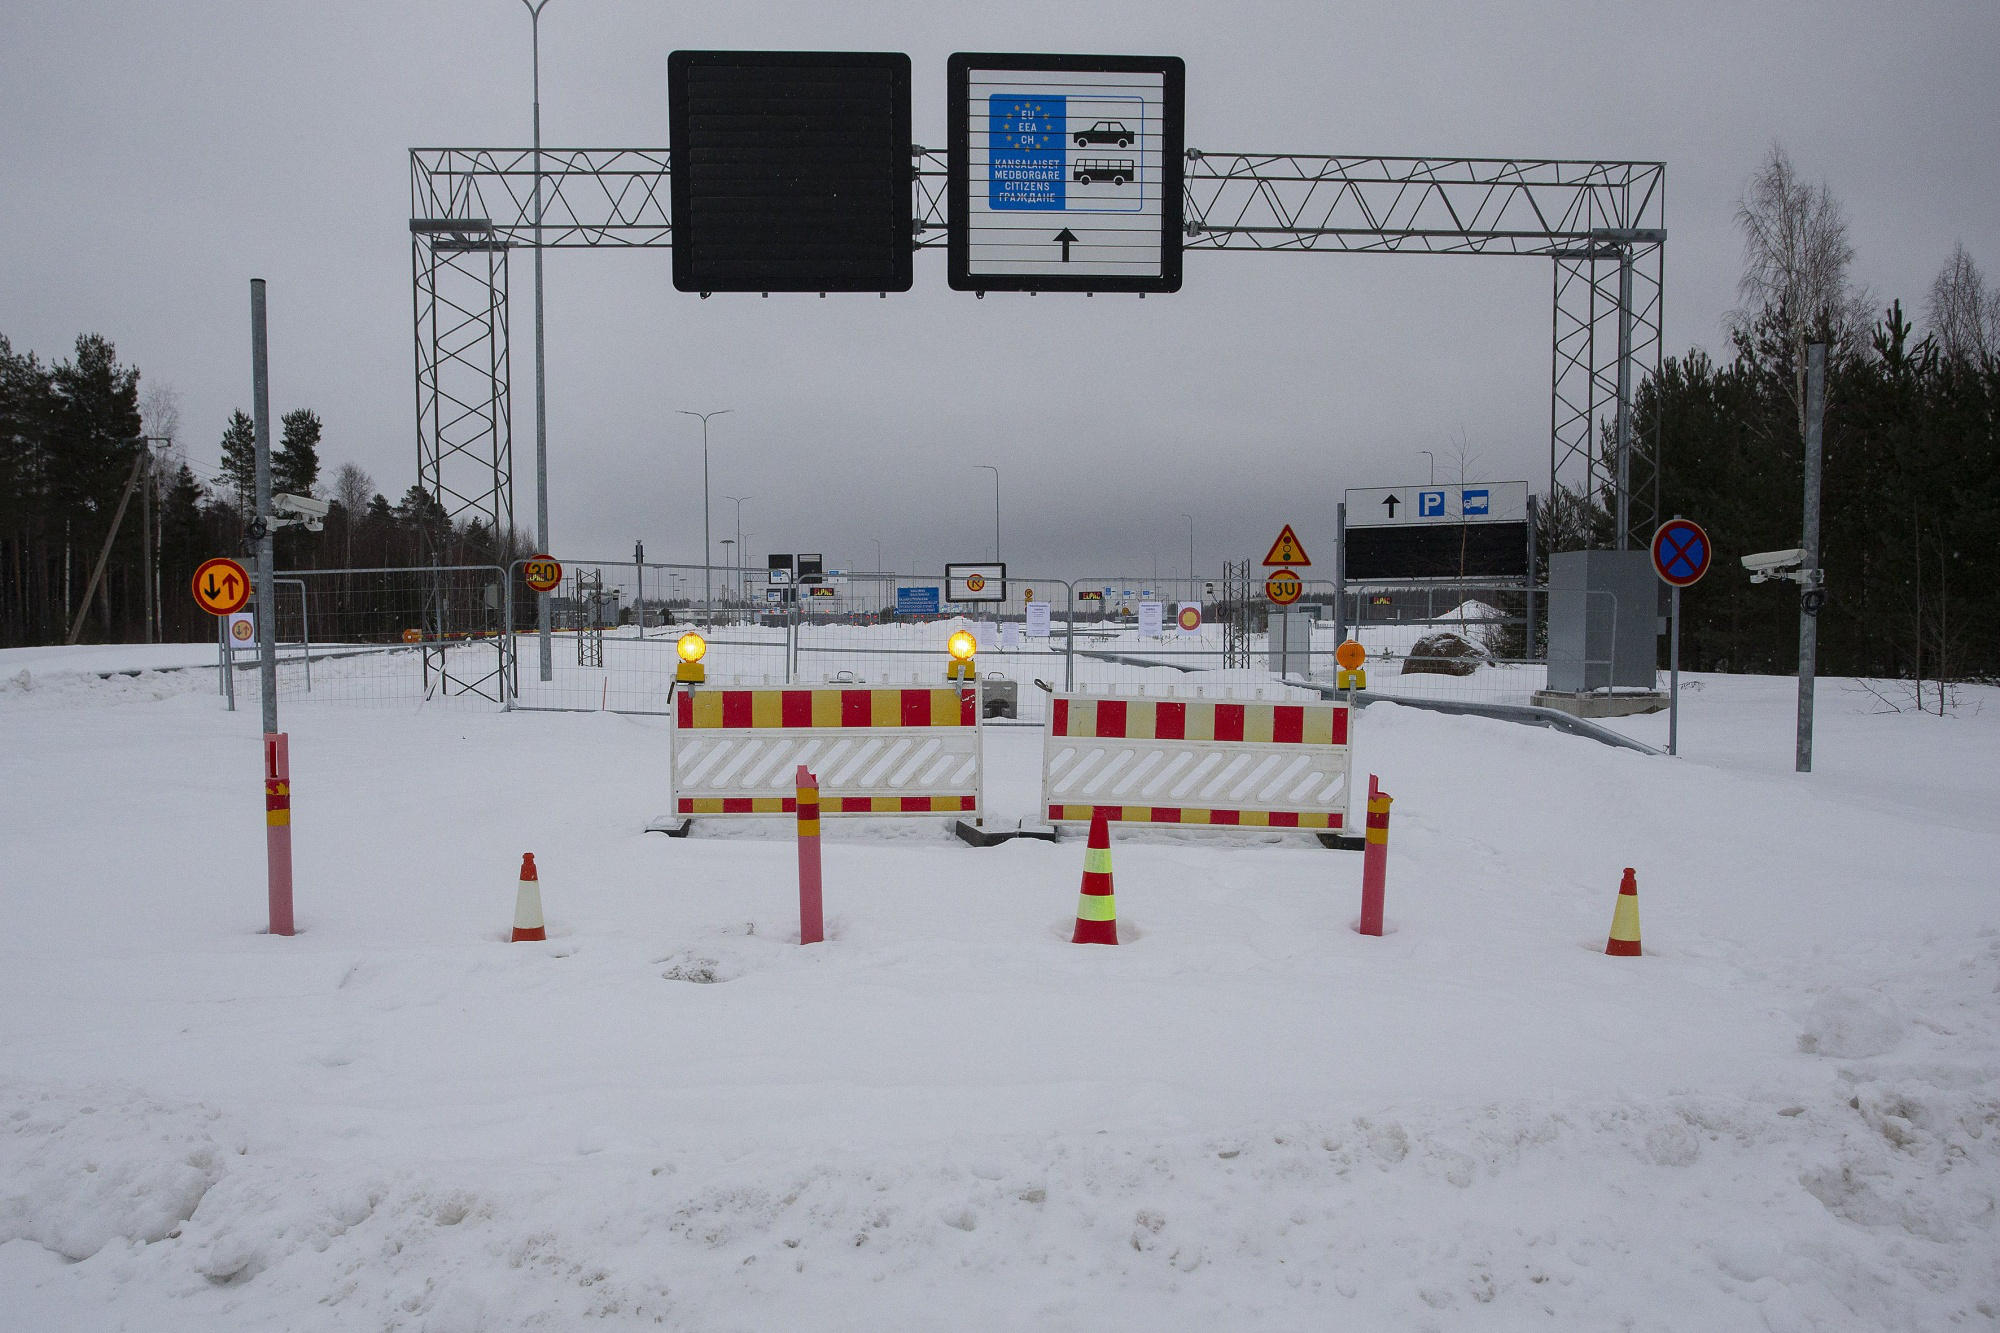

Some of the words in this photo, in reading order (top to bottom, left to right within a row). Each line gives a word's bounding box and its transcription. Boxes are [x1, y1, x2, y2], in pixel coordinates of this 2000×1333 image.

[1021, 110, 1035, 120] EU
[1018, 122, 1037, 132] EEA
[1021, 135, 1034, 145] CH
[995, 159, 1060, 170] KANSALAISET
[994, 170, 1060, 180] MEDBORGARE
[1004, 181, 1050, 191] CITIZENS
[999, 192, 1056, 203] ГРАЖДАНЕ
[1424, 493, 1441, 516] P
[1272, 577, 1295, 597] 30
